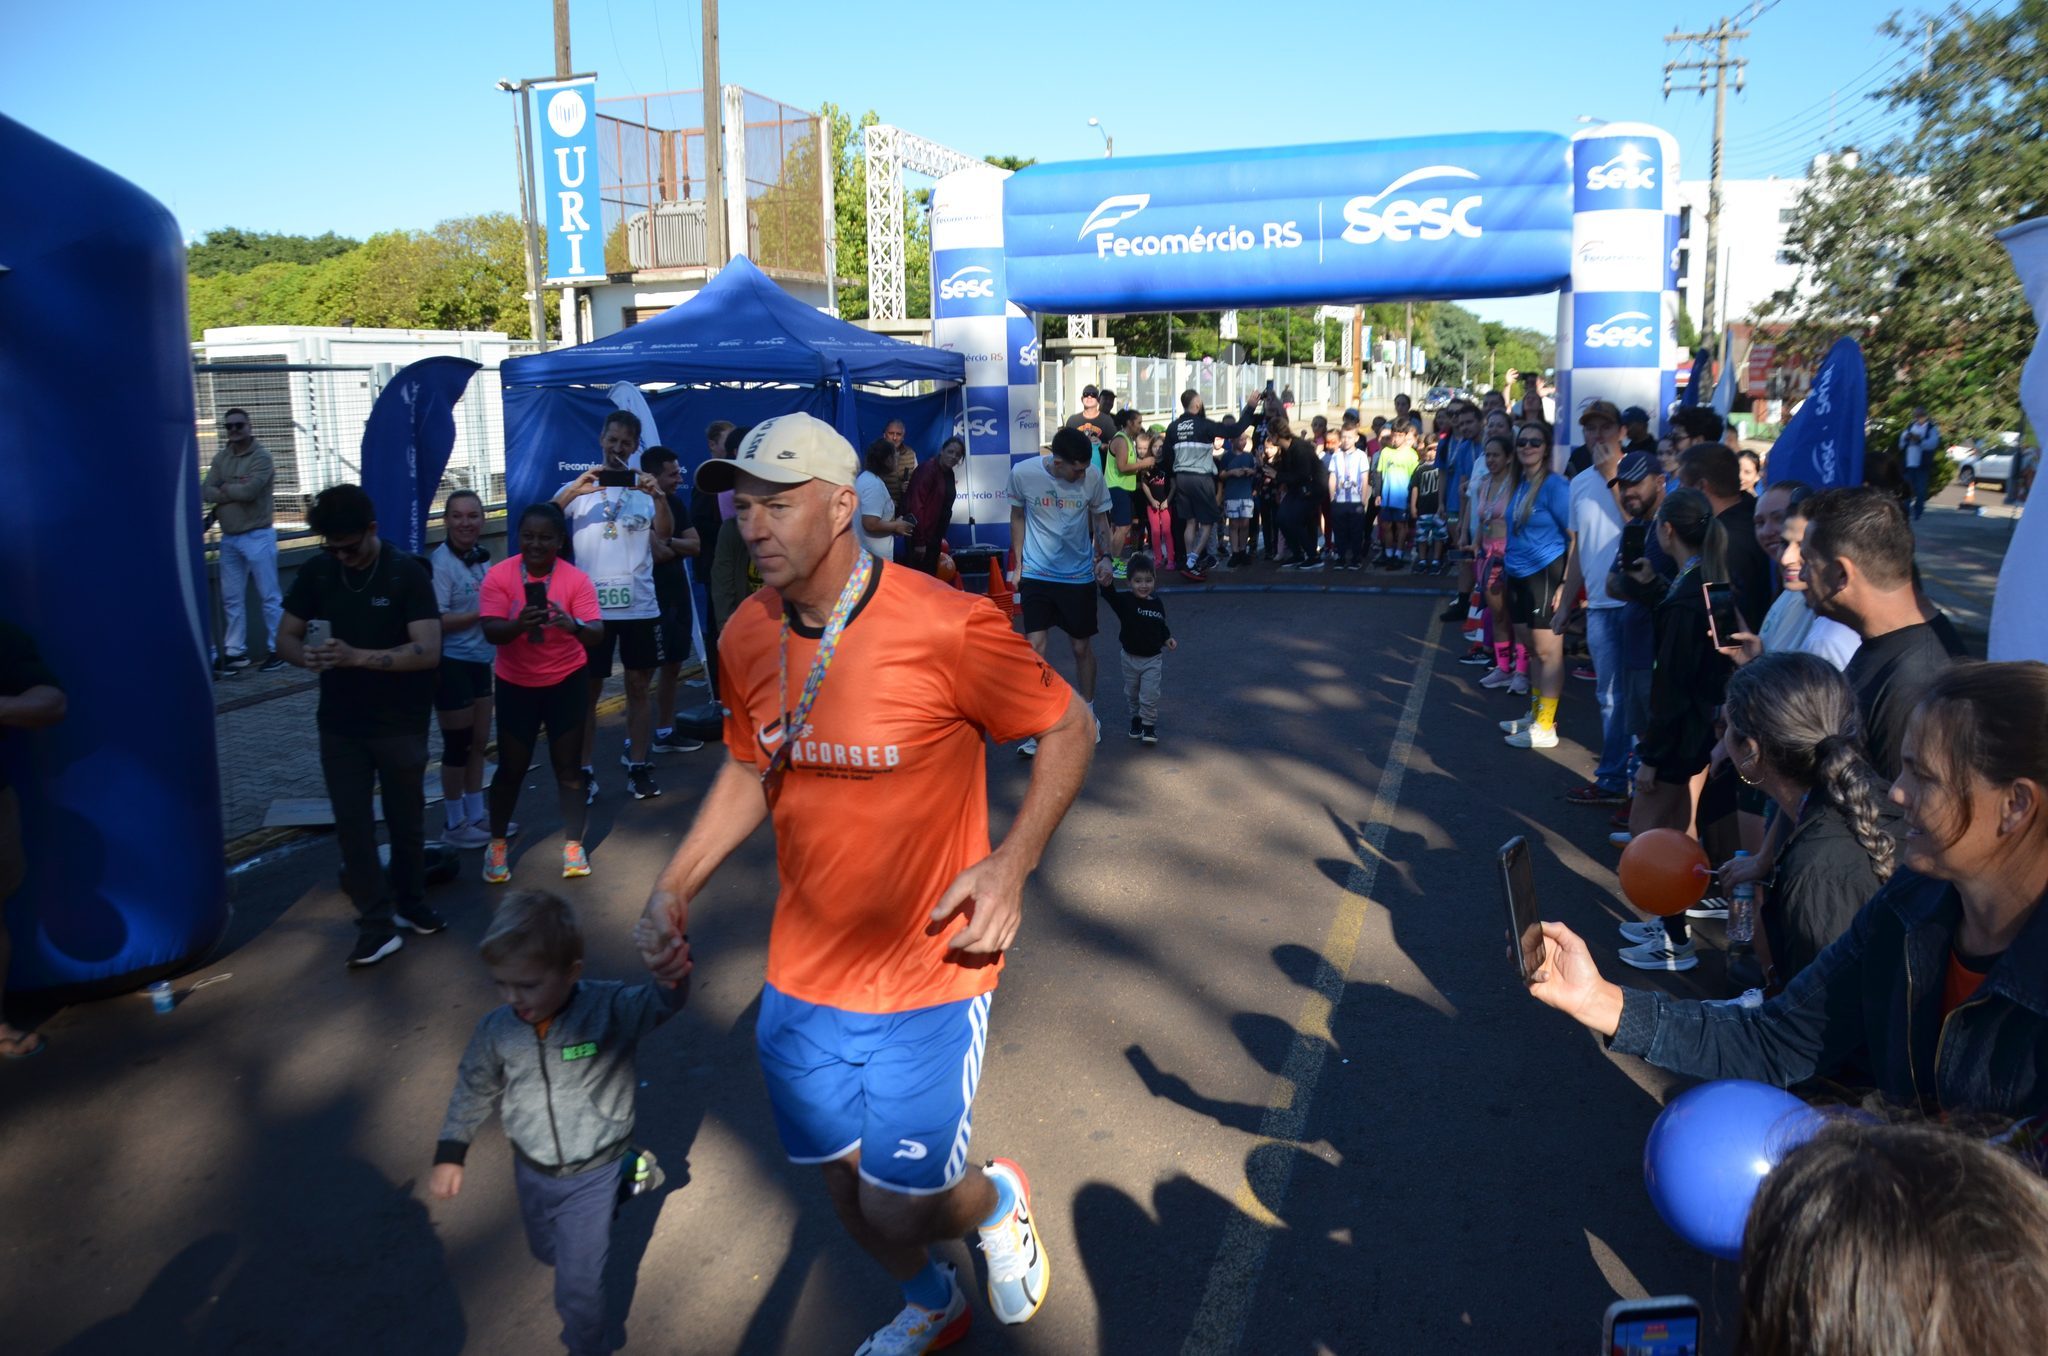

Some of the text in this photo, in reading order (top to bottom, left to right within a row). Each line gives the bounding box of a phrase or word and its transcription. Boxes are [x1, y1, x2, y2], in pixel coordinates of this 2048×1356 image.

[554, 146, 590, 274] URI
[1340, 194, 1483, 244] Sesc
[1096, 220, 1303, 259] Fecomércio RS
[940, 278, 994, 300] Sesc
[1584, 323, 1653, 348] Sesc
[965, 353, 988, 362] ércio
[1019, 345, 1039, 366] Se
[744, 432, 767, 460] JUST
[558, 461, 603, 471] Fecomér
[408, 501, 420, 554] dicatos
[792, 739, 900, 768] ACORSEB
